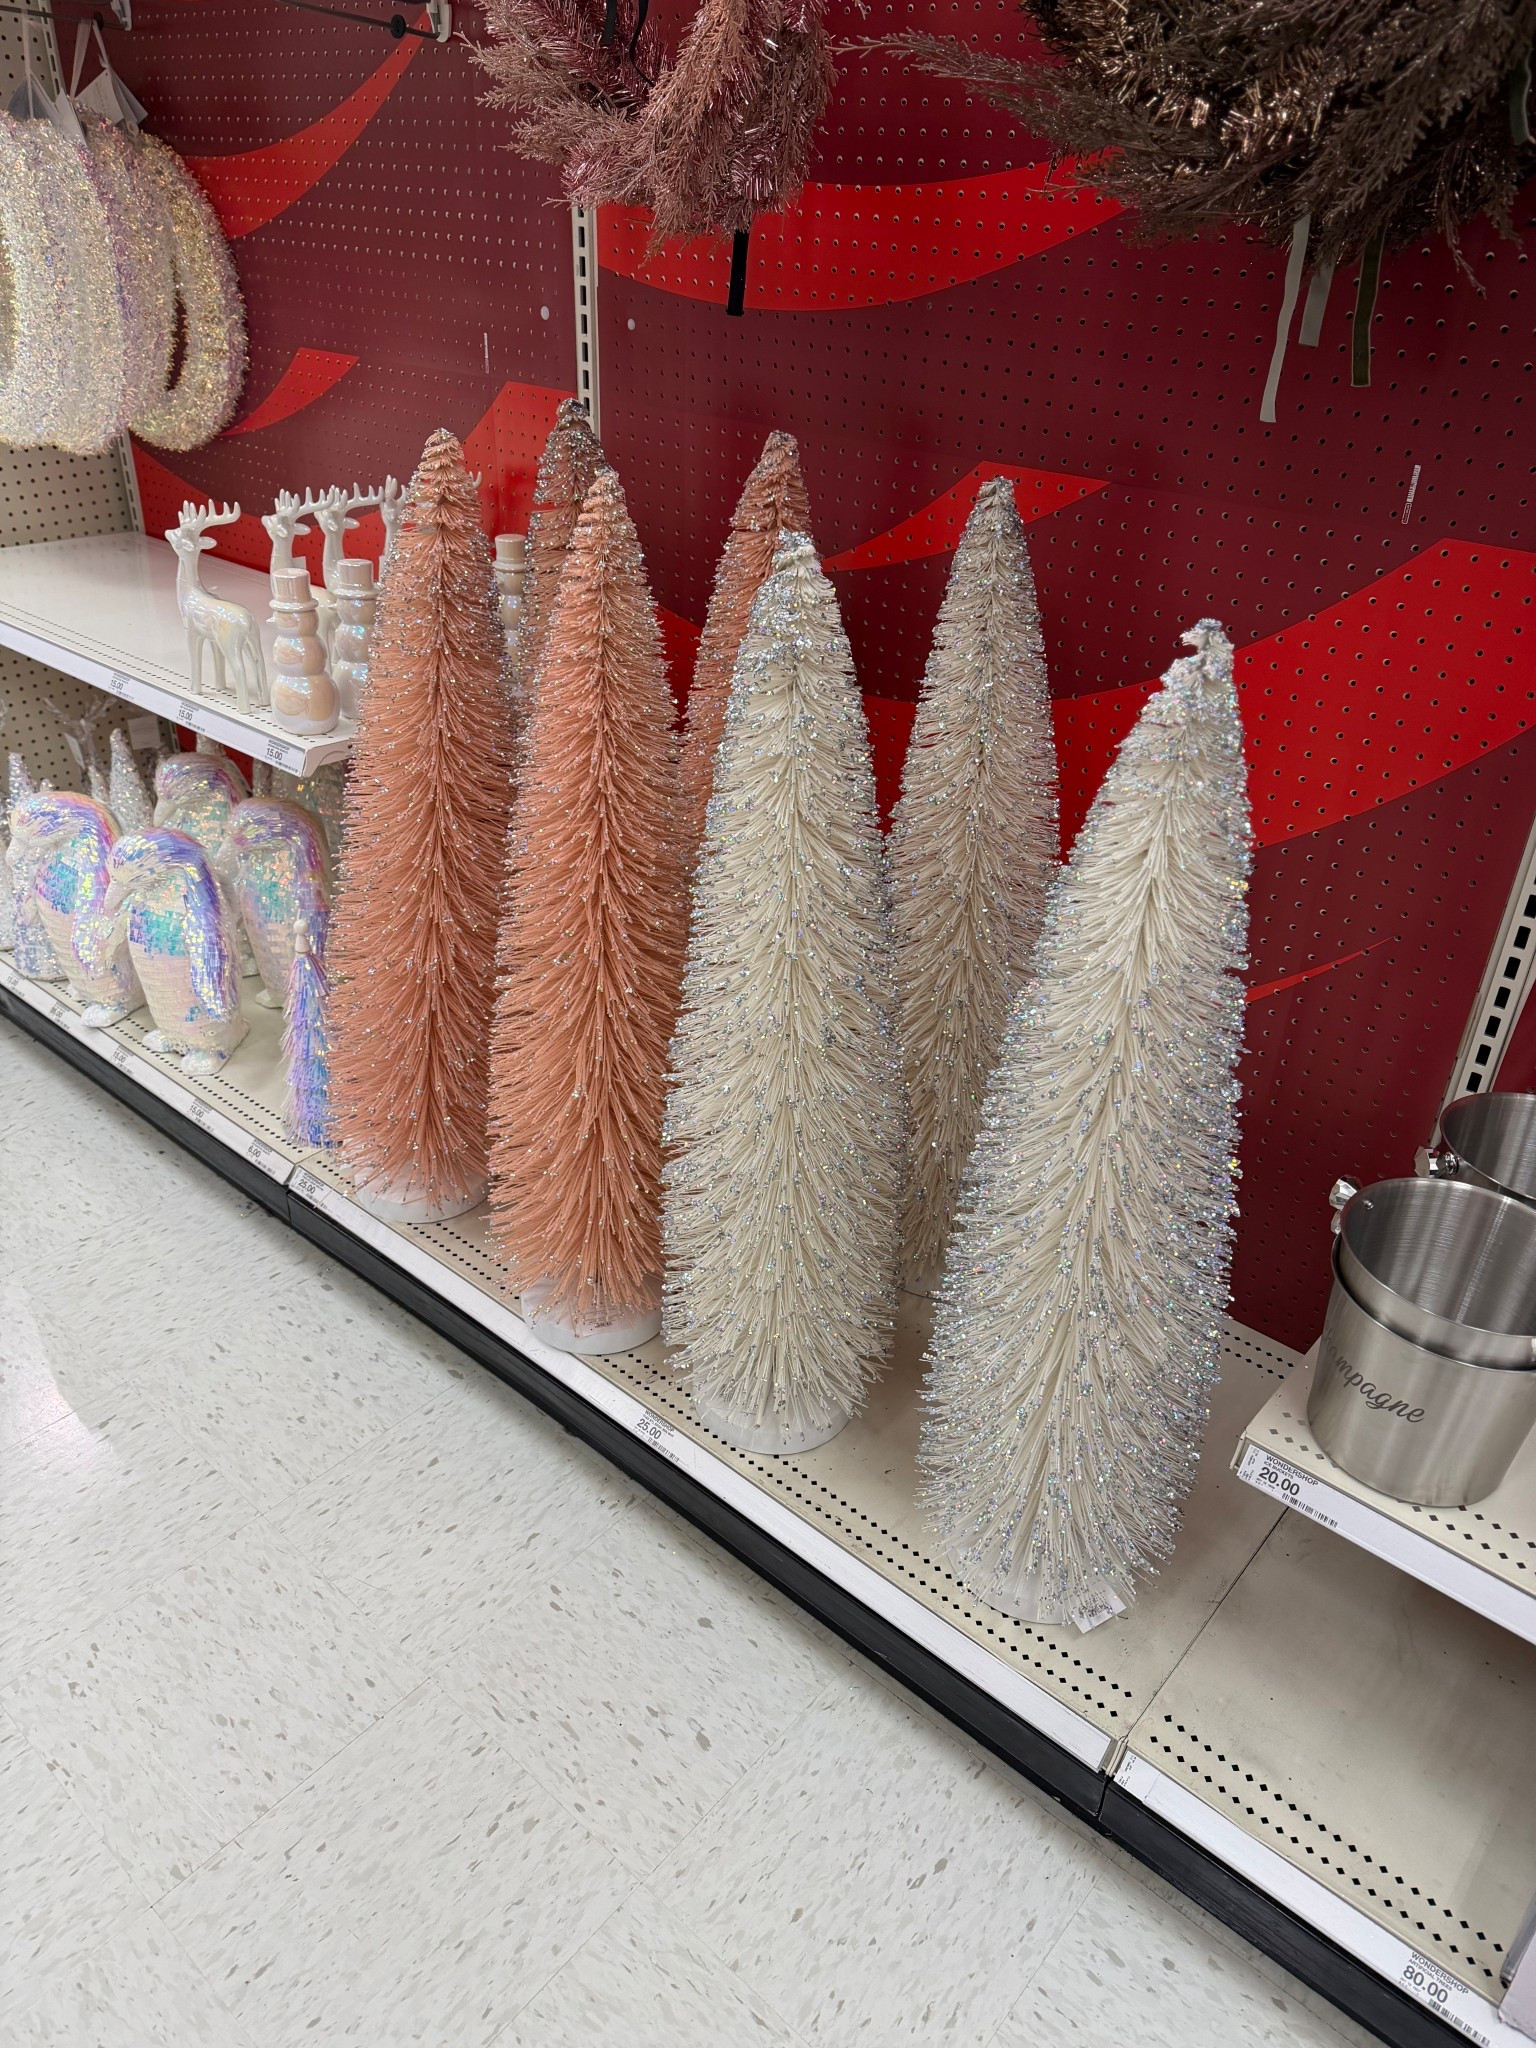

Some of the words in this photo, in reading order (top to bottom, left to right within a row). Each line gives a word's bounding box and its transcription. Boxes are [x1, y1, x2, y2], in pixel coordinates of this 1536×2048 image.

[179, 709, 193, 721] 15.00
[266, 747, 283, 761] 15.00
[189, 1104, 205, 1119] 15.00
[247, 1145, 262, 1158] 6.00
[298, 1178, 316, 1194] 25.00
[636, 1418, 662, 1440] 25.00
[644, 1409, 675, 1433] WONDERSHOP
[1258, 1466, 1300, 1496] 20.00
[1266, 1454, 1319, 1486] WONDERSHOP
[1272, 1464, 1294, 1480] BUCKETS
[1408, 1959, 1435, 1980] ARTIFICIAL
[1436, 1977, 1452, 1991] TREES
[1411, 1951, 1469, 1994] WONDERSHOP
[1403, 1965, 1448, 2003] 80.00
